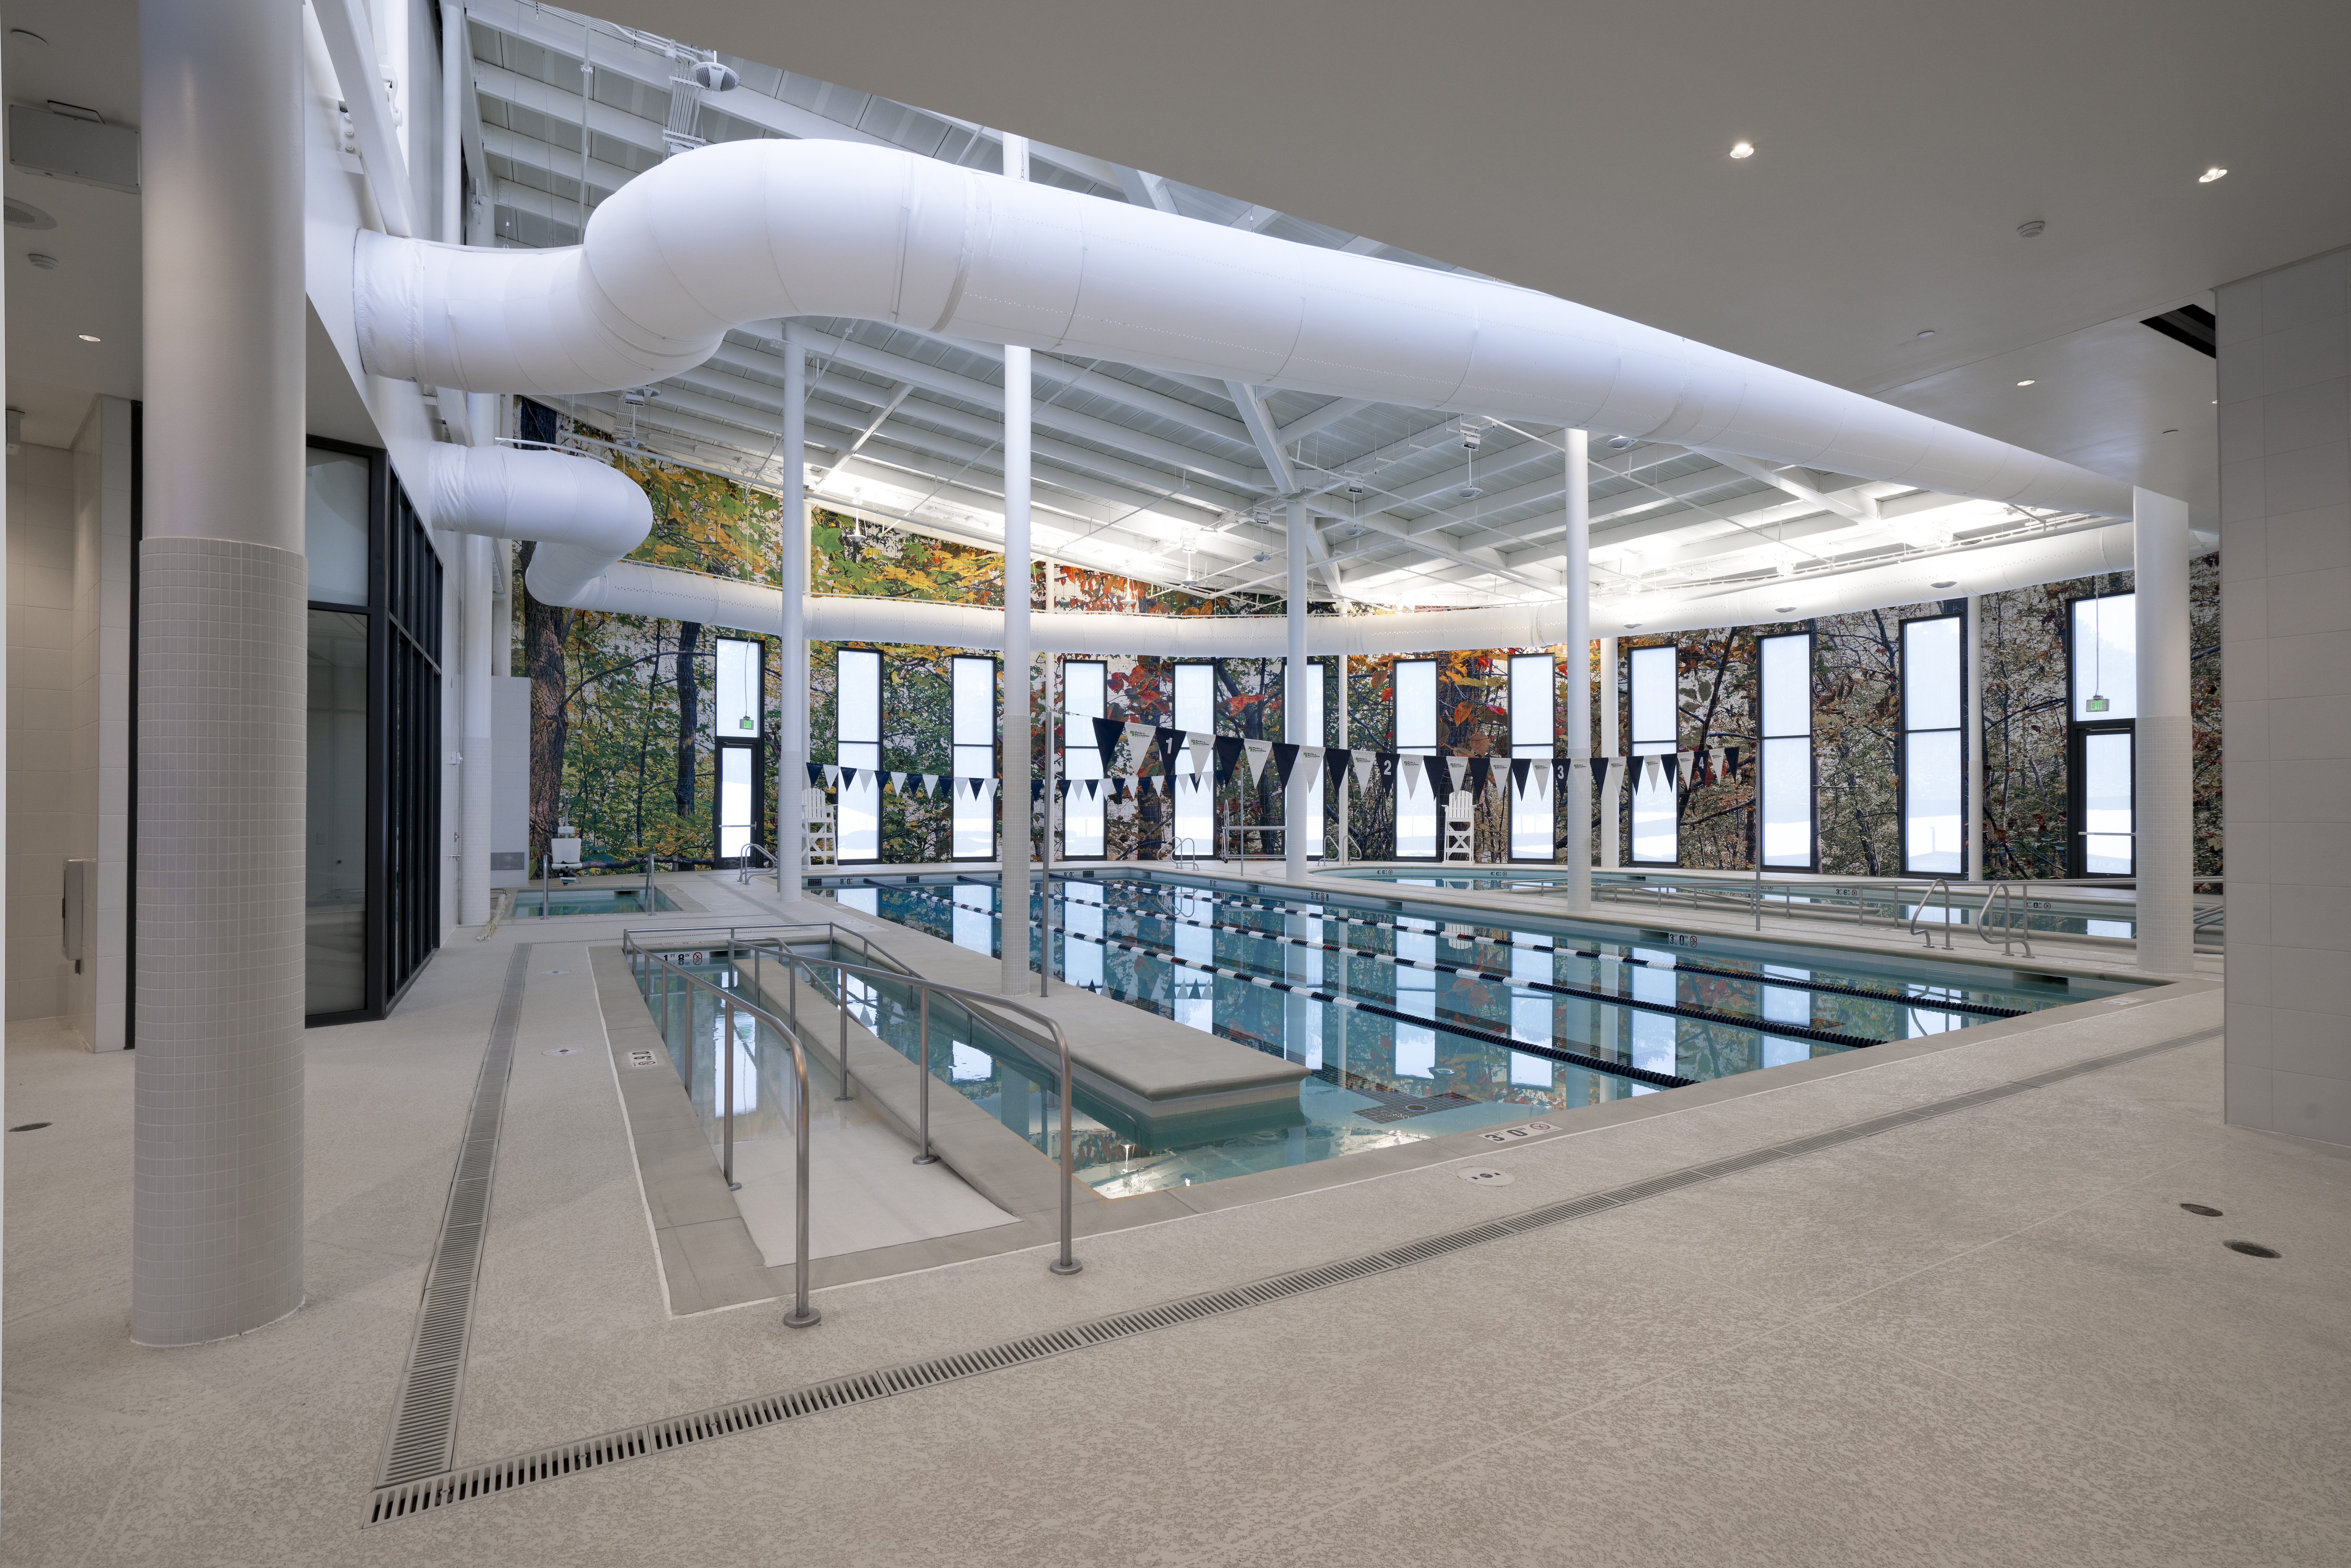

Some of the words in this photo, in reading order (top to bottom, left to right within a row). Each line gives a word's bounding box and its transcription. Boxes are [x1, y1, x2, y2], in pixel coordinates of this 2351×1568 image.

[2091, 701, 2103, 710] EXIT
[1166, 737, 1172, 754] 1
[1384, 760, 1391, 775] 2
[1699, 756, 1704, 769] 4
[1557, 765, 1564, 779] 3
